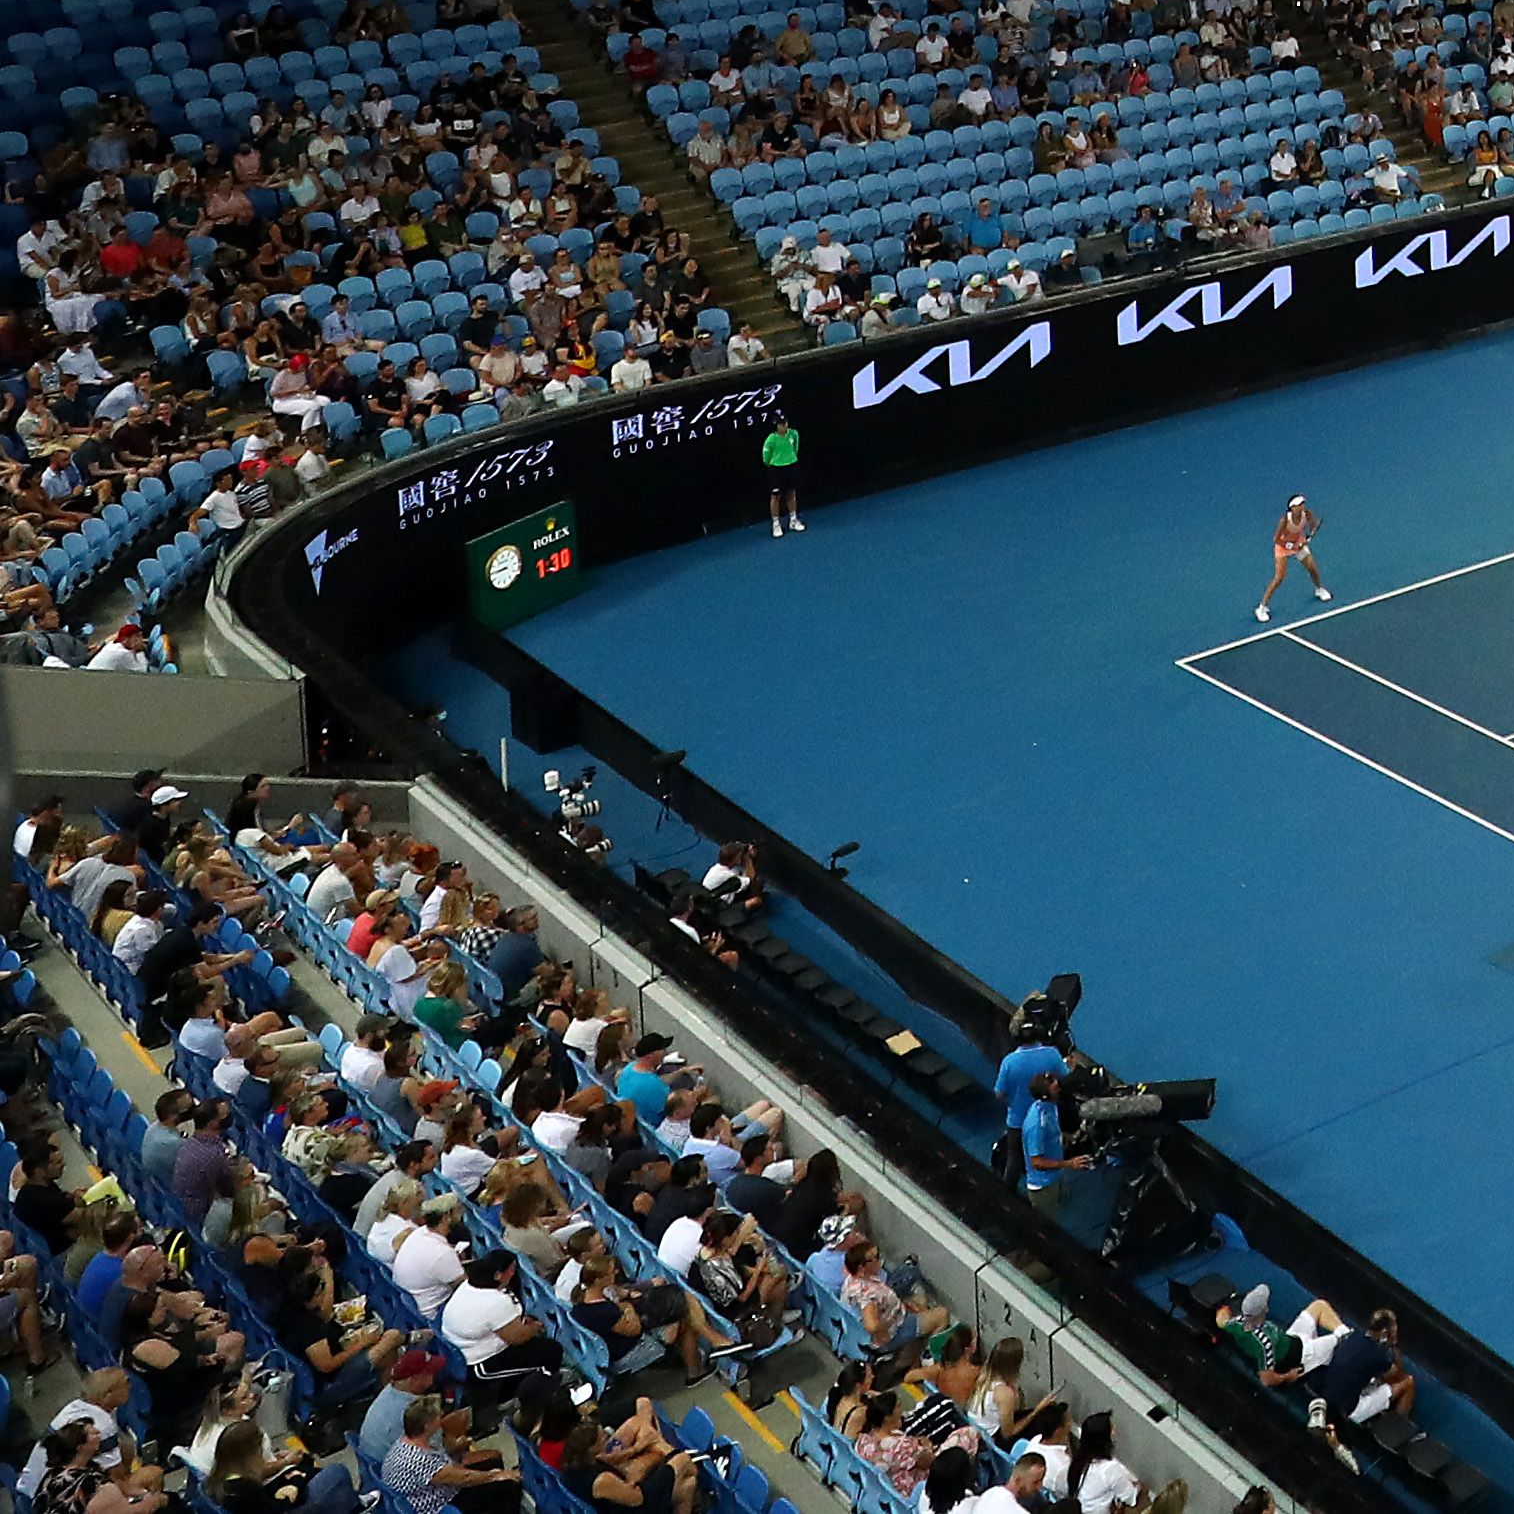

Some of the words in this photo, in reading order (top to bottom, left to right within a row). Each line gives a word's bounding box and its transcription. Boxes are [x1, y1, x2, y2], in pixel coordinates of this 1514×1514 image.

[1354, 214, 1511, 289] KIA
[1116, 265, 1293, 346] KIA
[852, 321, 1051, 410] KIA
[612, 425, 713, 459] GUOJIAO
[399, 487, 489, 530] GUOJIAO
[504, 465, 556, 492] 1573
[533, 525, 571, 550] ROLEX
[535, 547, 572, 579] 1:30
